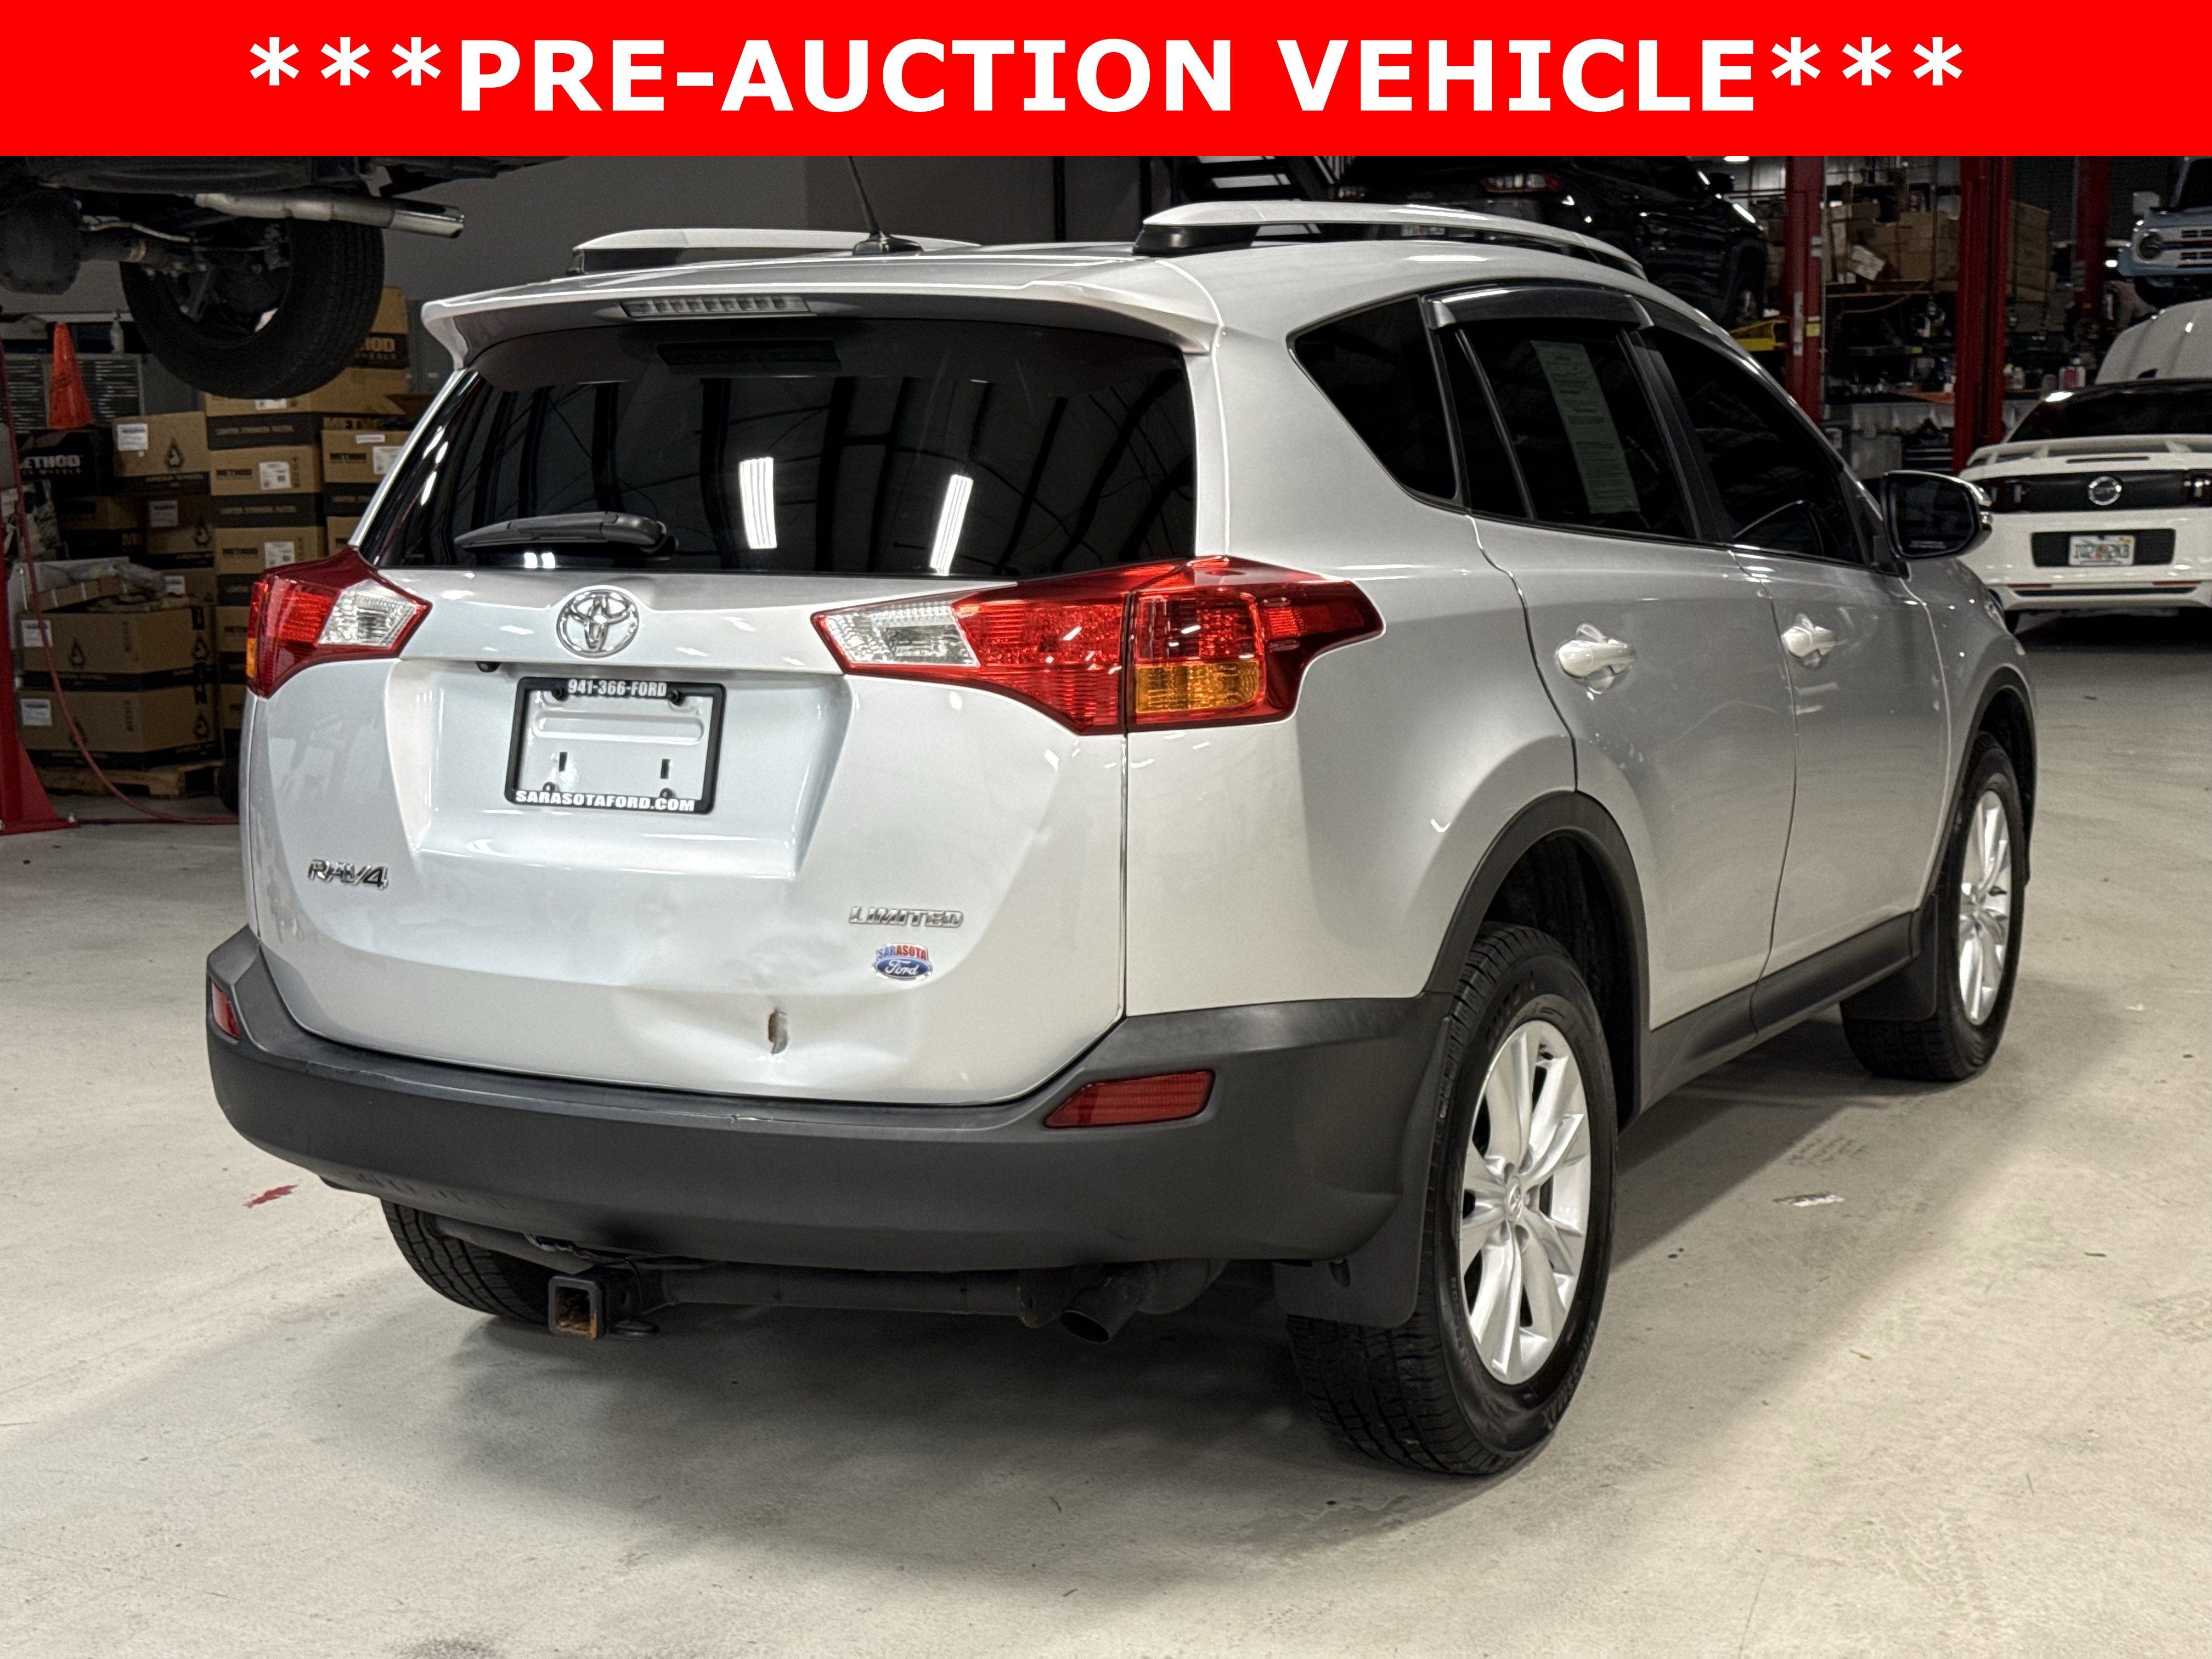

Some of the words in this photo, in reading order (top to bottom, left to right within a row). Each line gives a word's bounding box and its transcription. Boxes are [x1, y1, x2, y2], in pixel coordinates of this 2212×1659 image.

[19, 455, 81, 469] ETHOD
[567, 679, 667, 697] 941-366-FORD
[515, 789, 695, 812] SARASOTAFORD.COM
[307, 859, 388, 890] RAV4
[849, 905, 964, 928] LIMITED
[878, 945, 928, 960] SARASOTA
[884, 959, 921, 975] Ford
